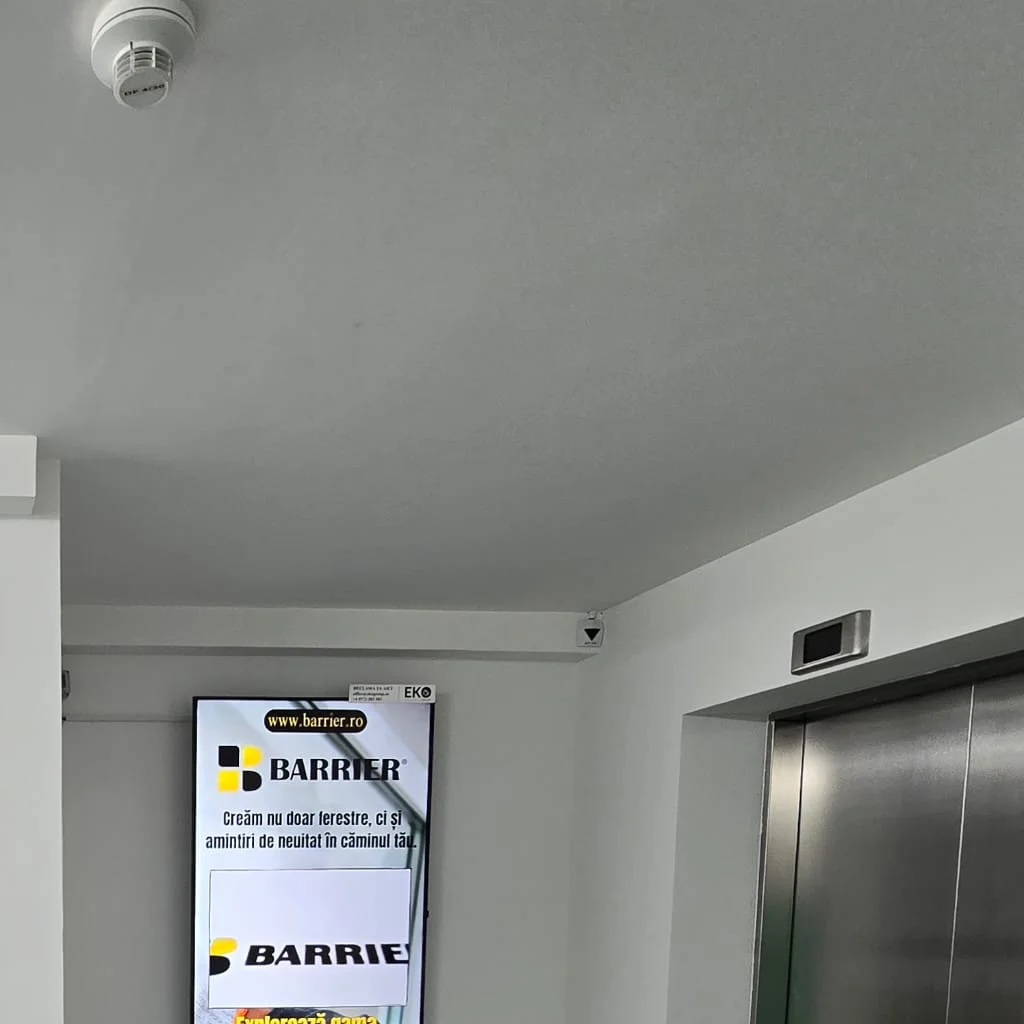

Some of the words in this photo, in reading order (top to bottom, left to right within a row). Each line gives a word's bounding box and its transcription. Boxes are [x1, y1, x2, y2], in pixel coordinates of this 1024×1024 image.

[267, 712, 364, 728] www.barrier.ro
[270, 758, 400, 781] BARRIER
[223, 809, 263, 826] Creăm
[267, 813, 282, 826] nu
[286, 811, 315, 826] doar
[319, 811, 372, 828] ferestre,
[376, 810, 387, 826] ci
[390, 810, 402, 830] și
[205, 833, 255, 849] amintiri
[259, 834, 274, 849] de
[278, 833, 322, 849] neuitat
[324, 832, 337, 849] în
[340, 832, 390, 849] căminul
[244, 943, 410, 966] BARRIE
